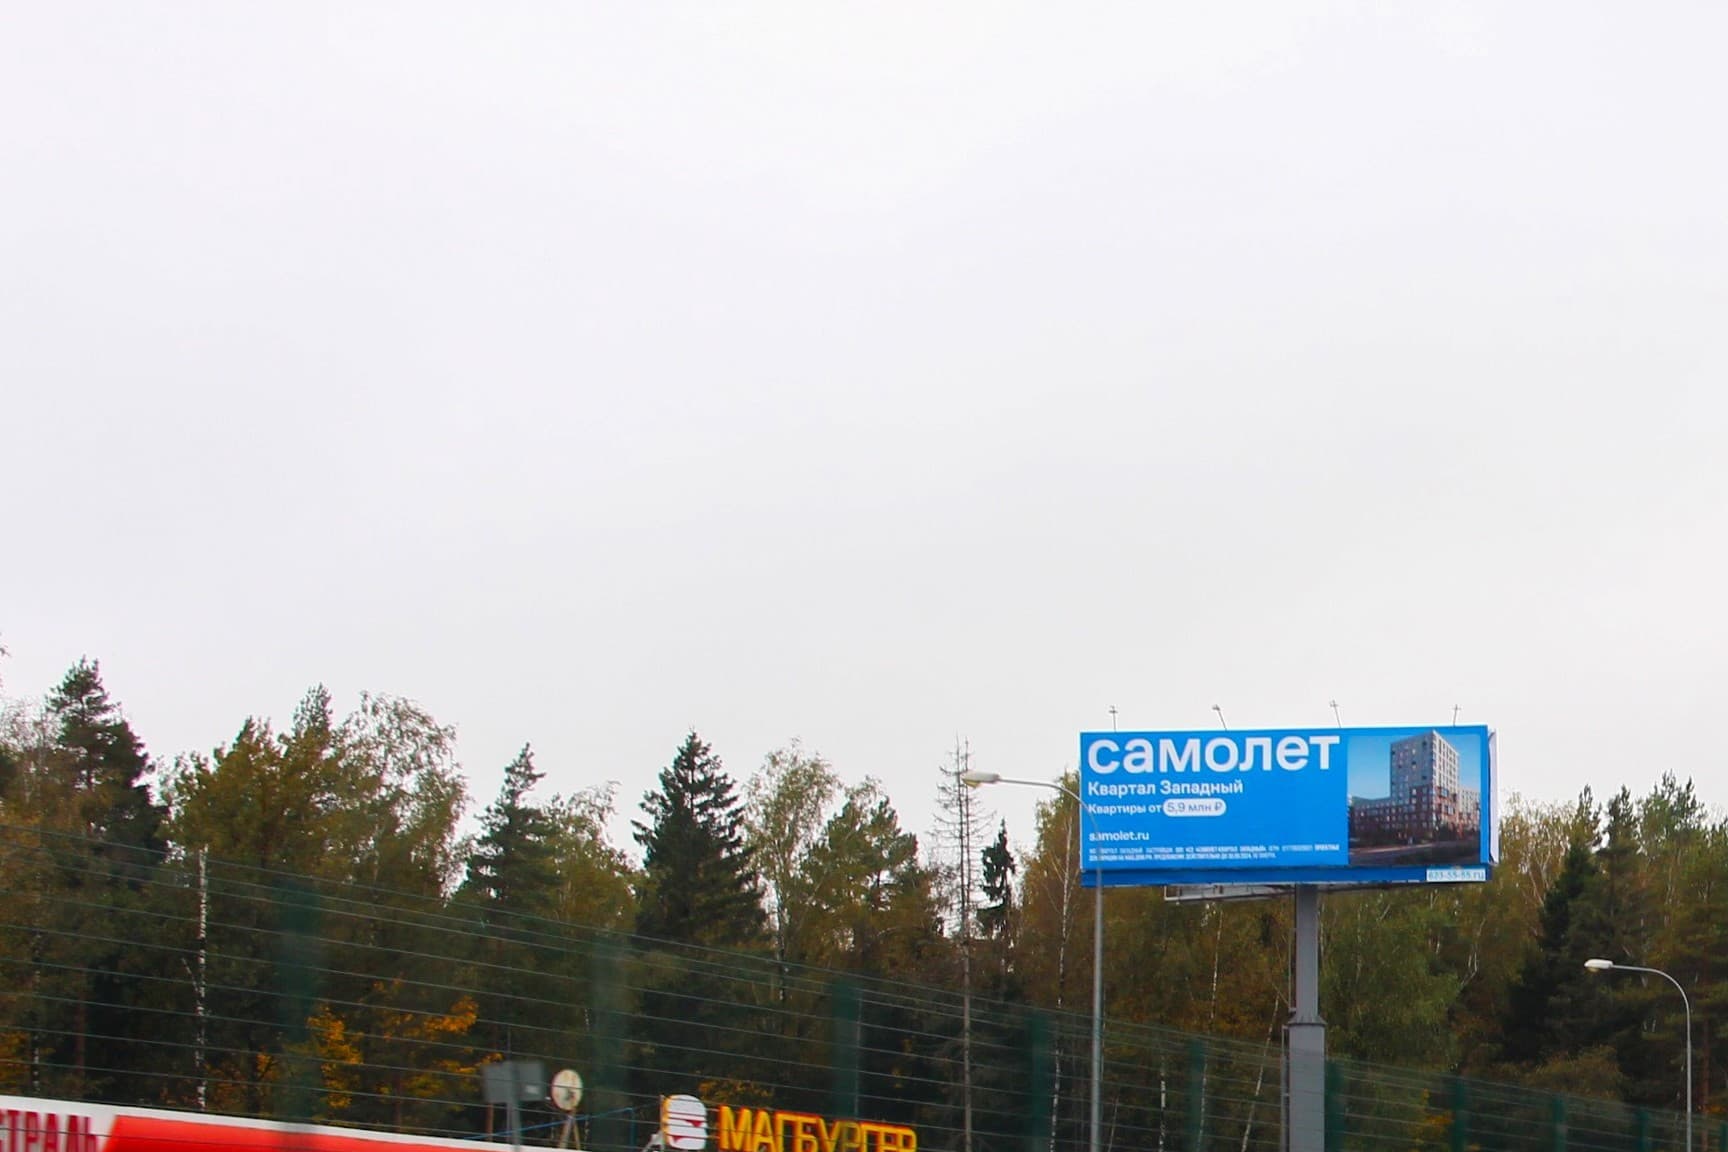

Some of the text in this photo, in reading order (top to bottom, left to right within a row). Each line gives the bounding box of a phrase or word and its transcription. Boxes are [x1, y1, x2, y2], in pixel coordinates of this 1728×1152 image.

[1088, 735, 1340, 774] самолет
[1088, 779, 1244, 799] Квартал Западный
[1088, 803, 1146, 816] Квартиры
[1148, 804, 1162, 813] от
[1167, 802, 1186, 815] 5,9
[1188, 803, 1212, 812] млн
[1088, 831, 1150, 841] samolet.ru
